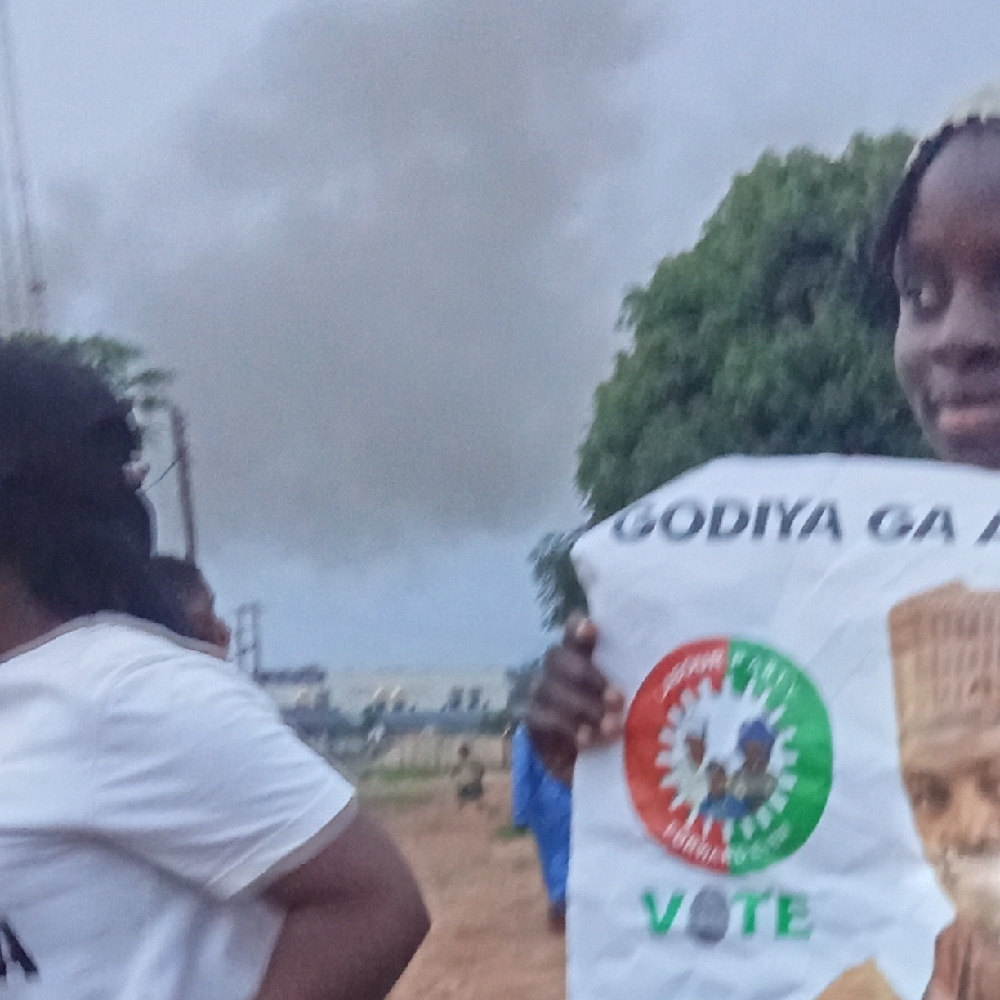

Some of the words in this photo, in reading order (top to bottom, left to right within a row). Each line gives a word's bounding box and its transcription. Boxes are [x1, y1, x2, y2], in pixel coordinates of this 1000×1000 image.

[612, 498, 844, 543] GODIYA
[868, 503, 955, 546] GA
[642, 887, 813, 943] VOTE
